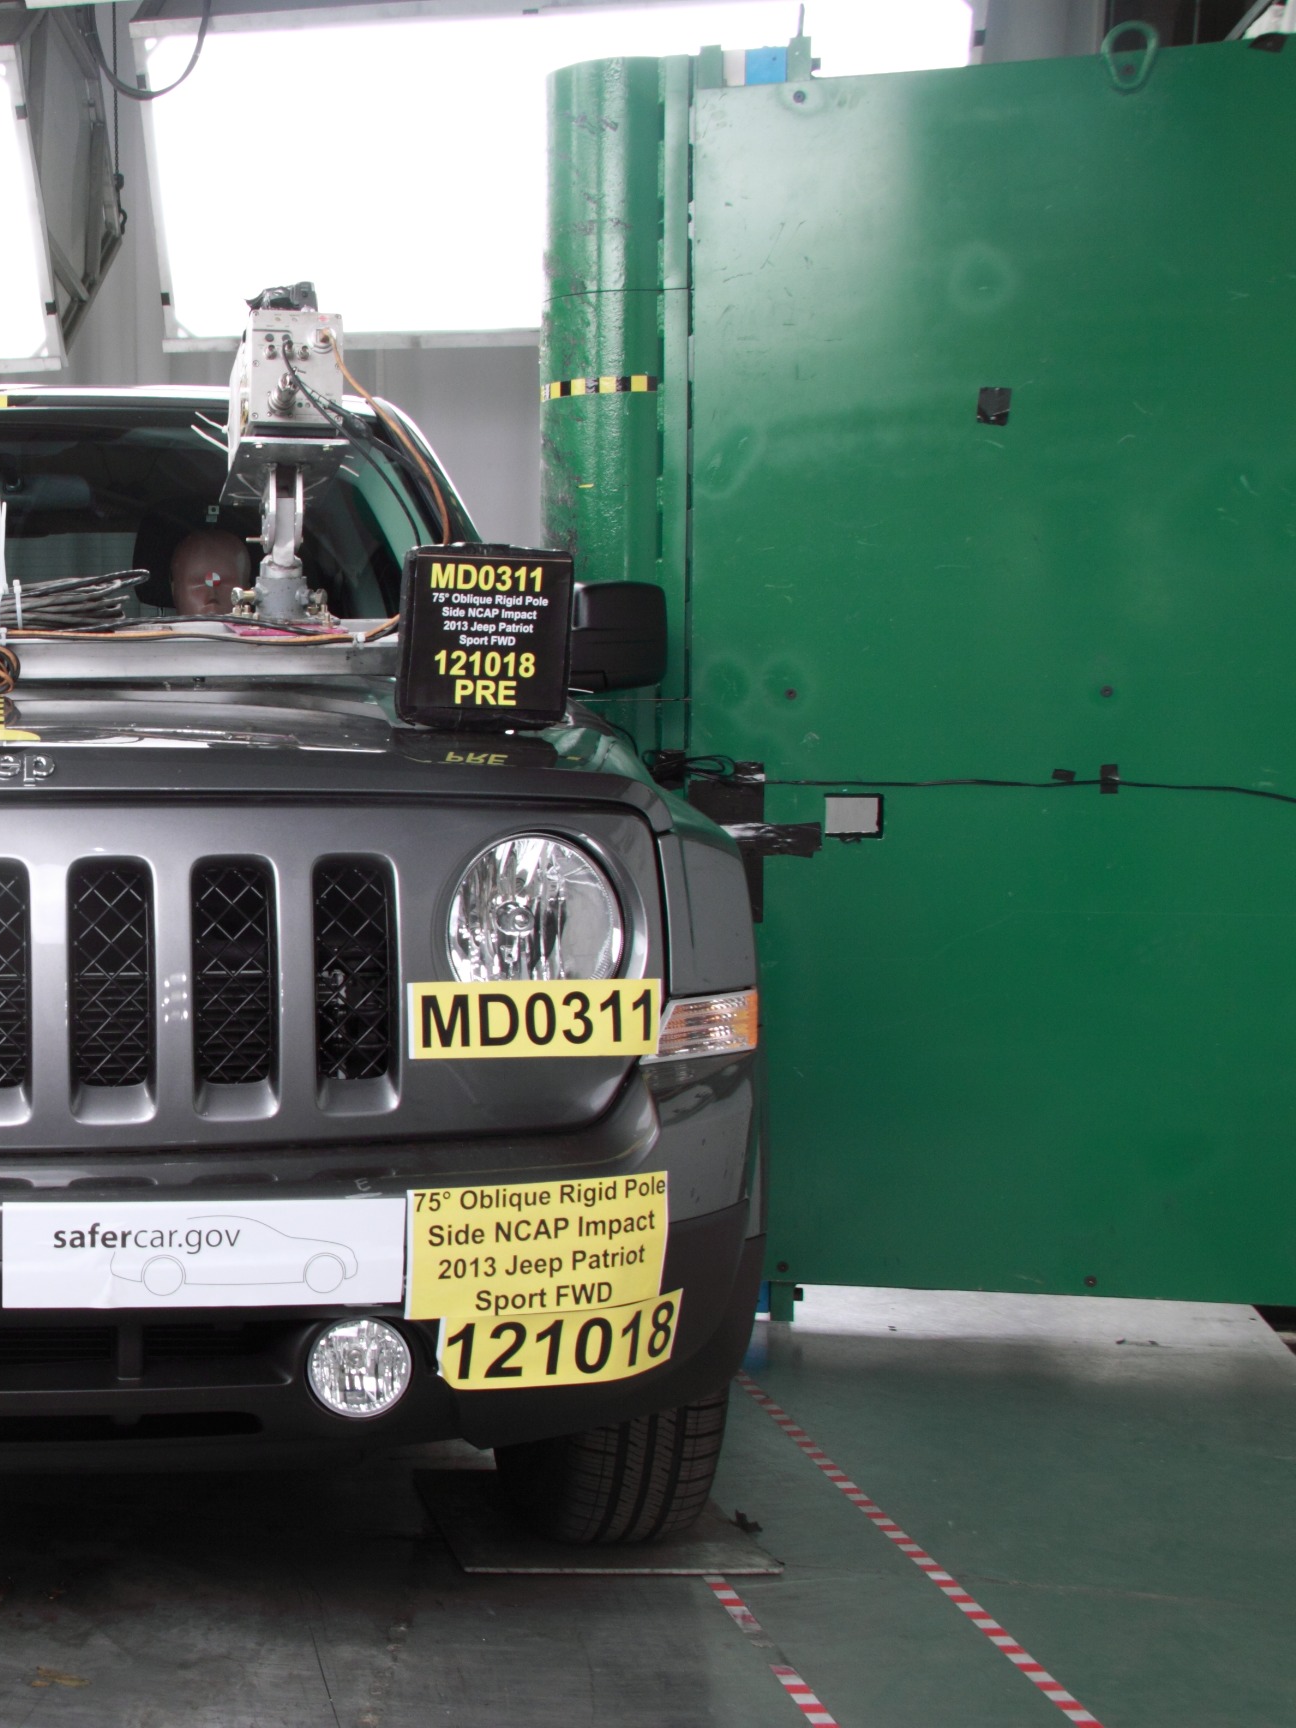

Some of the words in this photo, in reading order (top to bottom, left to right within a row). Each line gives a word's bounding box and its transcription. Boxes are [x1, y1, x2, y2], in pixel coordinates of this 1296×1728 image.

[430, 563, 543, 592] MD0311
[442, 606, 466, 617] Side
[467, 607, 500, 618] NCAP
[501, 609, 537, 621] Impact
[451, 593, 493, 606] Oblique
[495, 594, 523, 608] Rigid
[525, 596, 549, 606] Pole
[443, 620, 469, 631] 2013
[470, 621, 496, 634] Jeep
[498, 622, 534, 633] Patriot
[459, 634, 489, 647] Sport
[490, 636, 516, 646] FWD
[434, 650, 536, 678] 121018
[454, 679, 517, 706] PRE
[420, 988, 653, 1049] MD0311
[414, 1190, 451, 1212] 75°
[460, 1188, 552, 1212] Oblique
[559, 1180, 617, 1207] Rigid
[625, 1175, 666, 1199] Pole
[53, 1222, 241, 1255] safercar.gov
[428, 1223, 485, 1247] Side
[495, 1217, 569, 1243] NCAP
[578, 1209, 656, 1240] Impact
[437, 1256, 497, 1280] 2013
[505, 1254, 563, 1278] Jeep
[572, 1244, 646, 1271] Patriot
[475, 1287, 547, 1316] Sport
[556, 1281, 613, 1307] FWD
[446, 1300, 675, 1380] 121018
